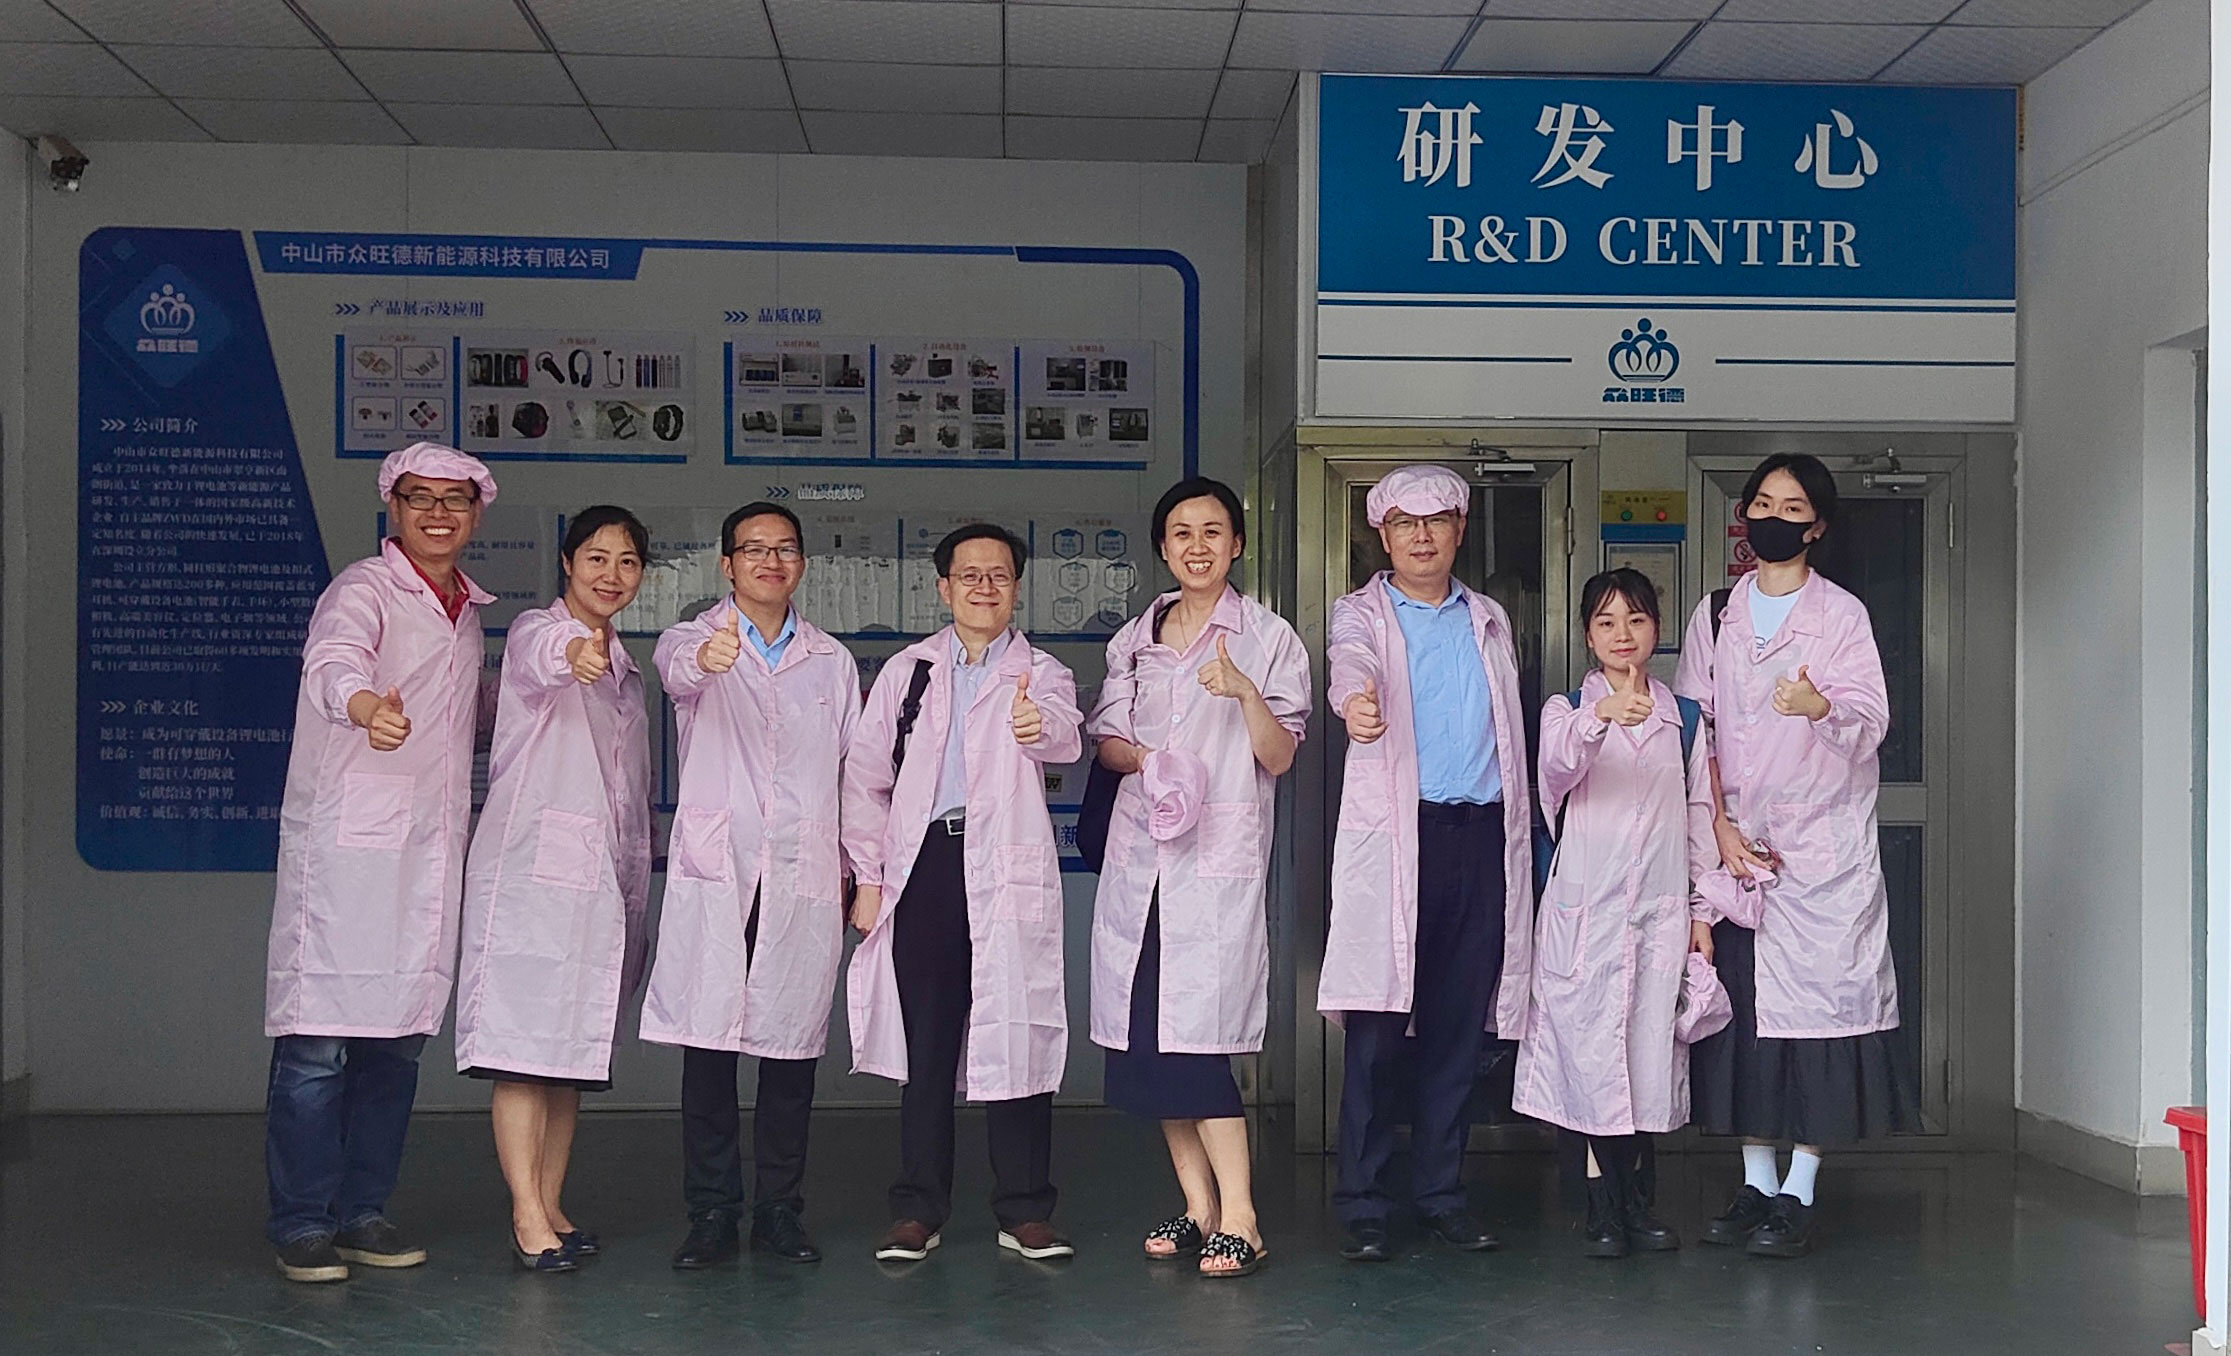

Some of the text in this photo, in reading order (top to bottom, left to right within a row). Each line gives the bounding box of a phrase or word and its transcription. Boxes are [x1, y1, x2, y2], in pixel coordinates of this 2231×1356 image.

[1396, 101, 1880, 192] 研发中心
[1427, 215, 1861, 268] R&D CENTER
[281, 243, 610, 269] 中山市众旺德新能源科技有限公司
[369, 300, 485, 318] 产品展示及应用
[757, 307, 823, 325] 品质保障
[132, 416, 200, 435] 公司简介
[133, 699, 200, 716] 企业文化
